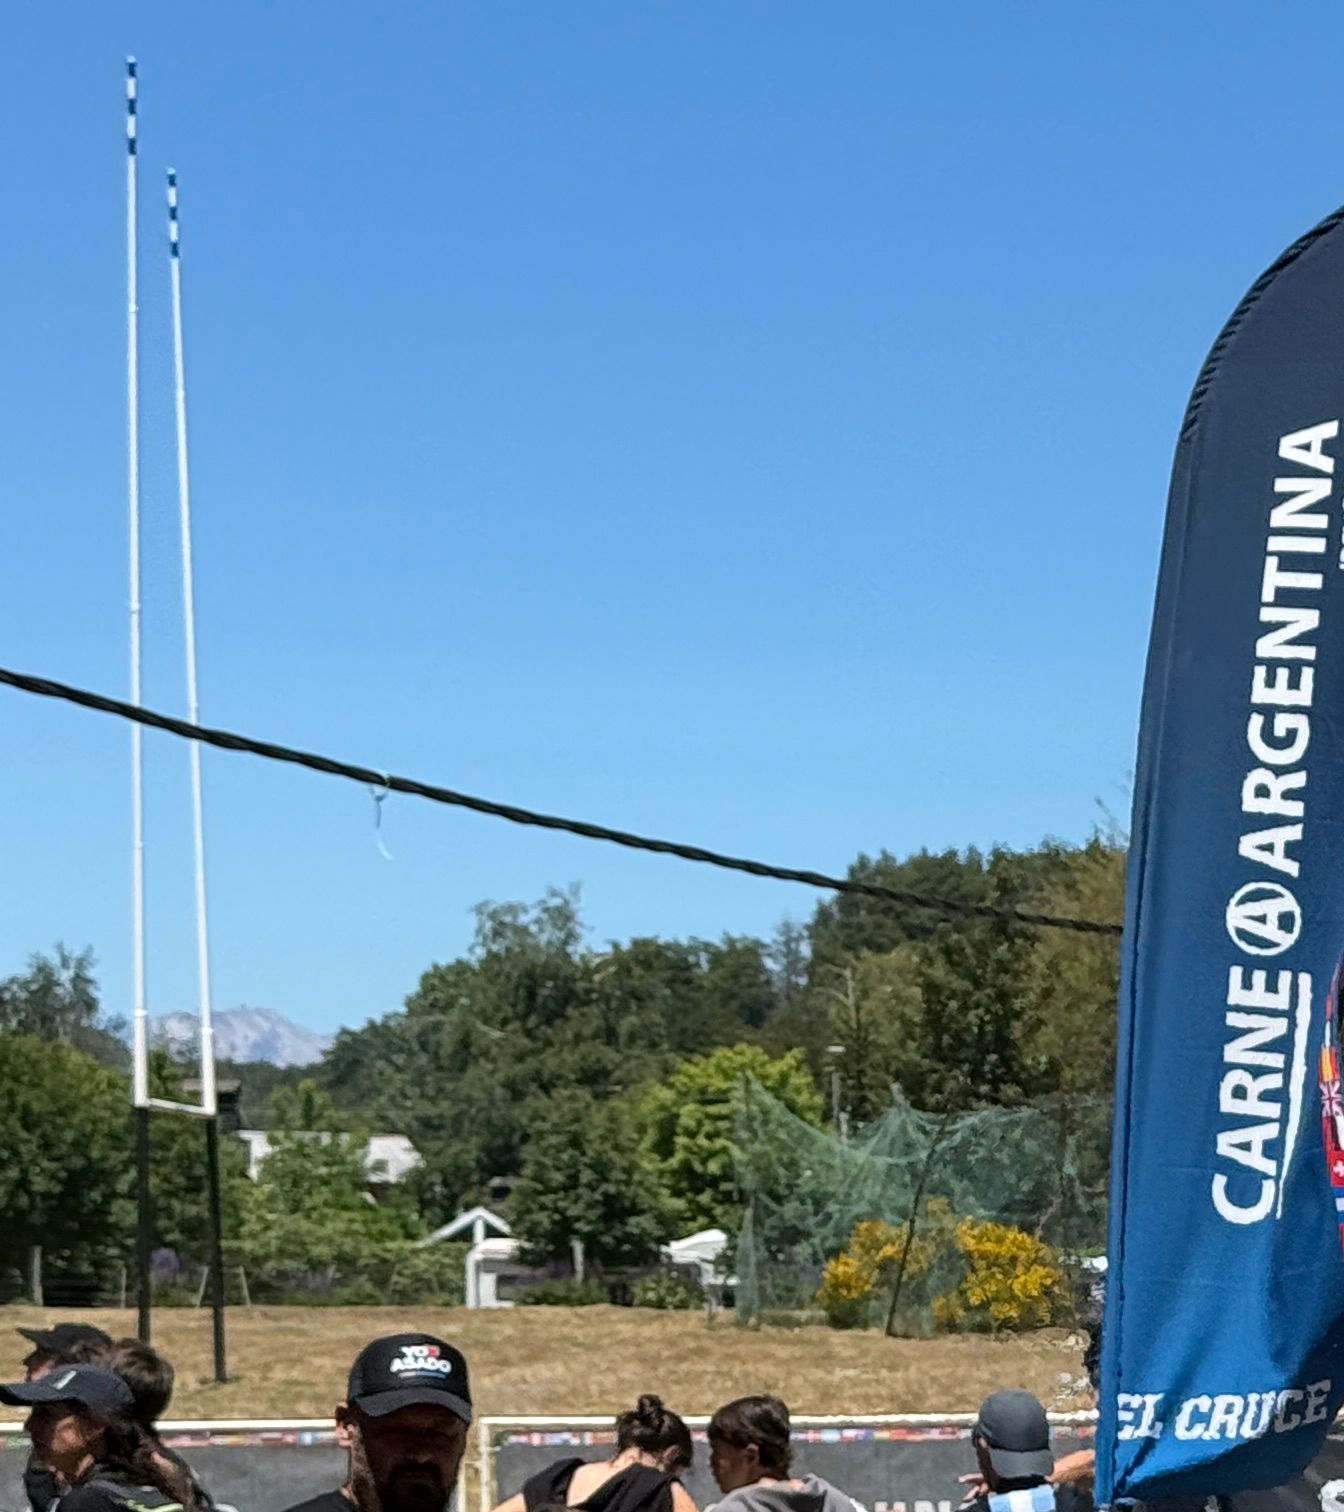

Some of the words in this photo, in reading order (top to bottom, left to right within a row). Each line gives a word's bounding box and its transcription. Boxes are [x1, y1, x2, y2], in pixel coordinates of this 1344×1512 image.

[1238, 419, 1340, 877] ARGENTINA
[1211, 964, 1293, 1224] CARNE
[390, 1357, 452, 1373] ASADO
[1117, 1391, 1166, 1441] EL
[1175, 1379, 1331, 1441] CRUCE
